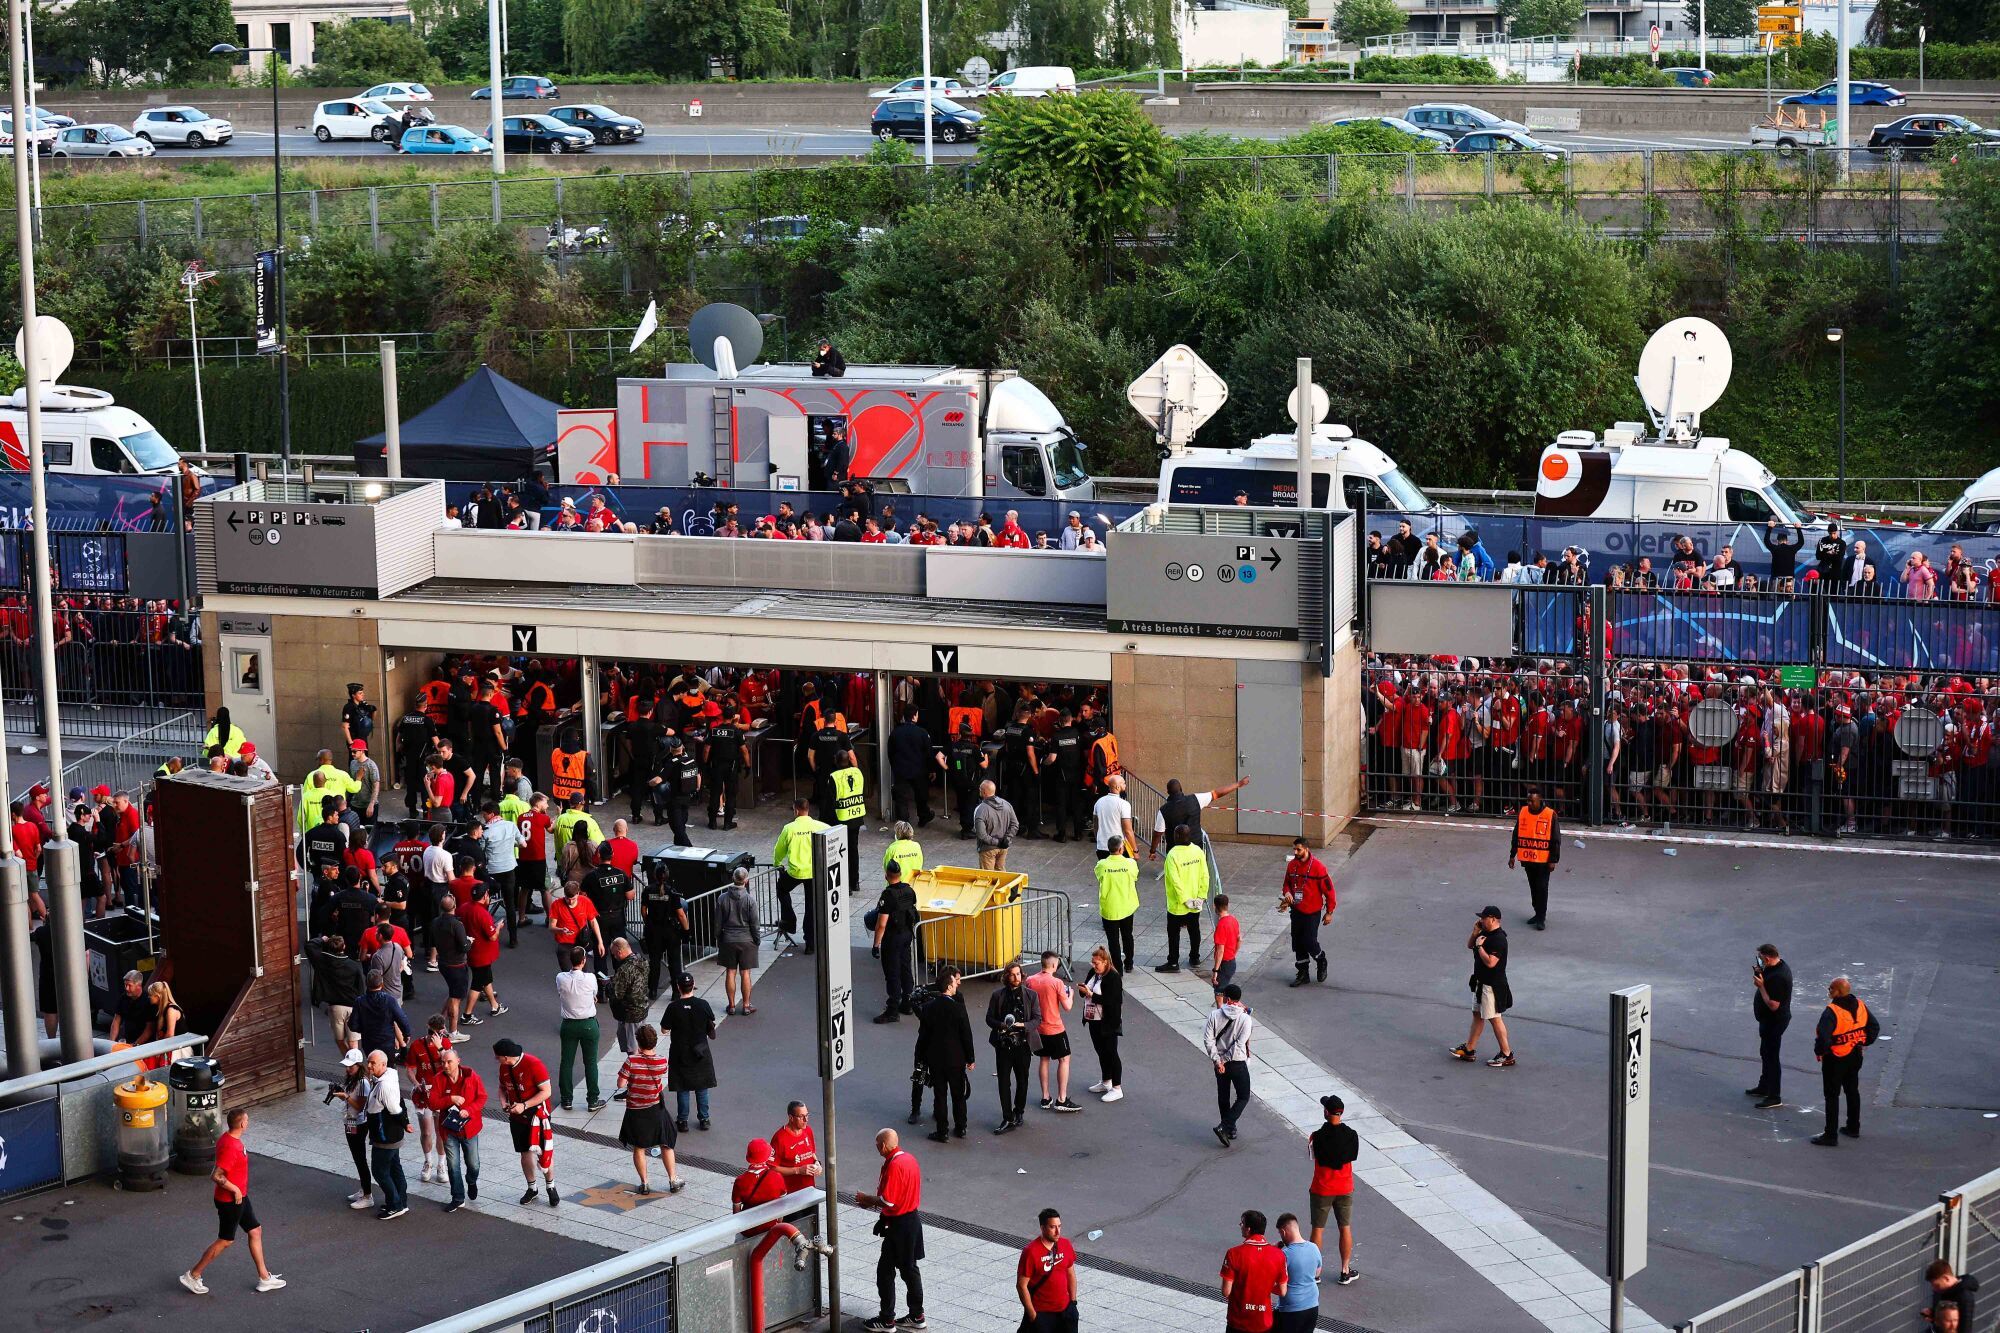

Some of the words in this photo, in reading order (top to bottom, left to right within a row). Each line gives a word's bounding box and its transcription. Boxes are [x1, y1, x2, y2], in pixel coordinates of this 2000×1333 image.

[1662, 499, 1698, 513] HD
[230, 584, 255, 592] Sortie
[257, 585, 298, 595] définitive
[310, 587, 321, 596] No
[323, 588, 348, 597] Return
[350, 589, 365, 597] Exit
[1121, 621, 1129, 631] À
[1131, 623, 1152, 632] très
[1155, 624, 1193, 634] bientôt
[1215, 627, 1232, 635] See
[1234, 628, 1252, 638] you
[1255, 628, 1283, 638] soon!
[516, 631, 533, 651] Y
[935, 650, 955, 672] Y
[838, 796, 864, 808] STEWAR
[847, 807, 861, 816] 169
[520, 819, 532, 841] 8
[313, 842, 333, 850] POLICE
[401, 855, 423, 874] 40
[605, 877, 618, 885] C-10
[829, 867, 839, 890] Y
[833, 1016, 843, 1039] Y
[1629, 1034, 1640, 1062] X
